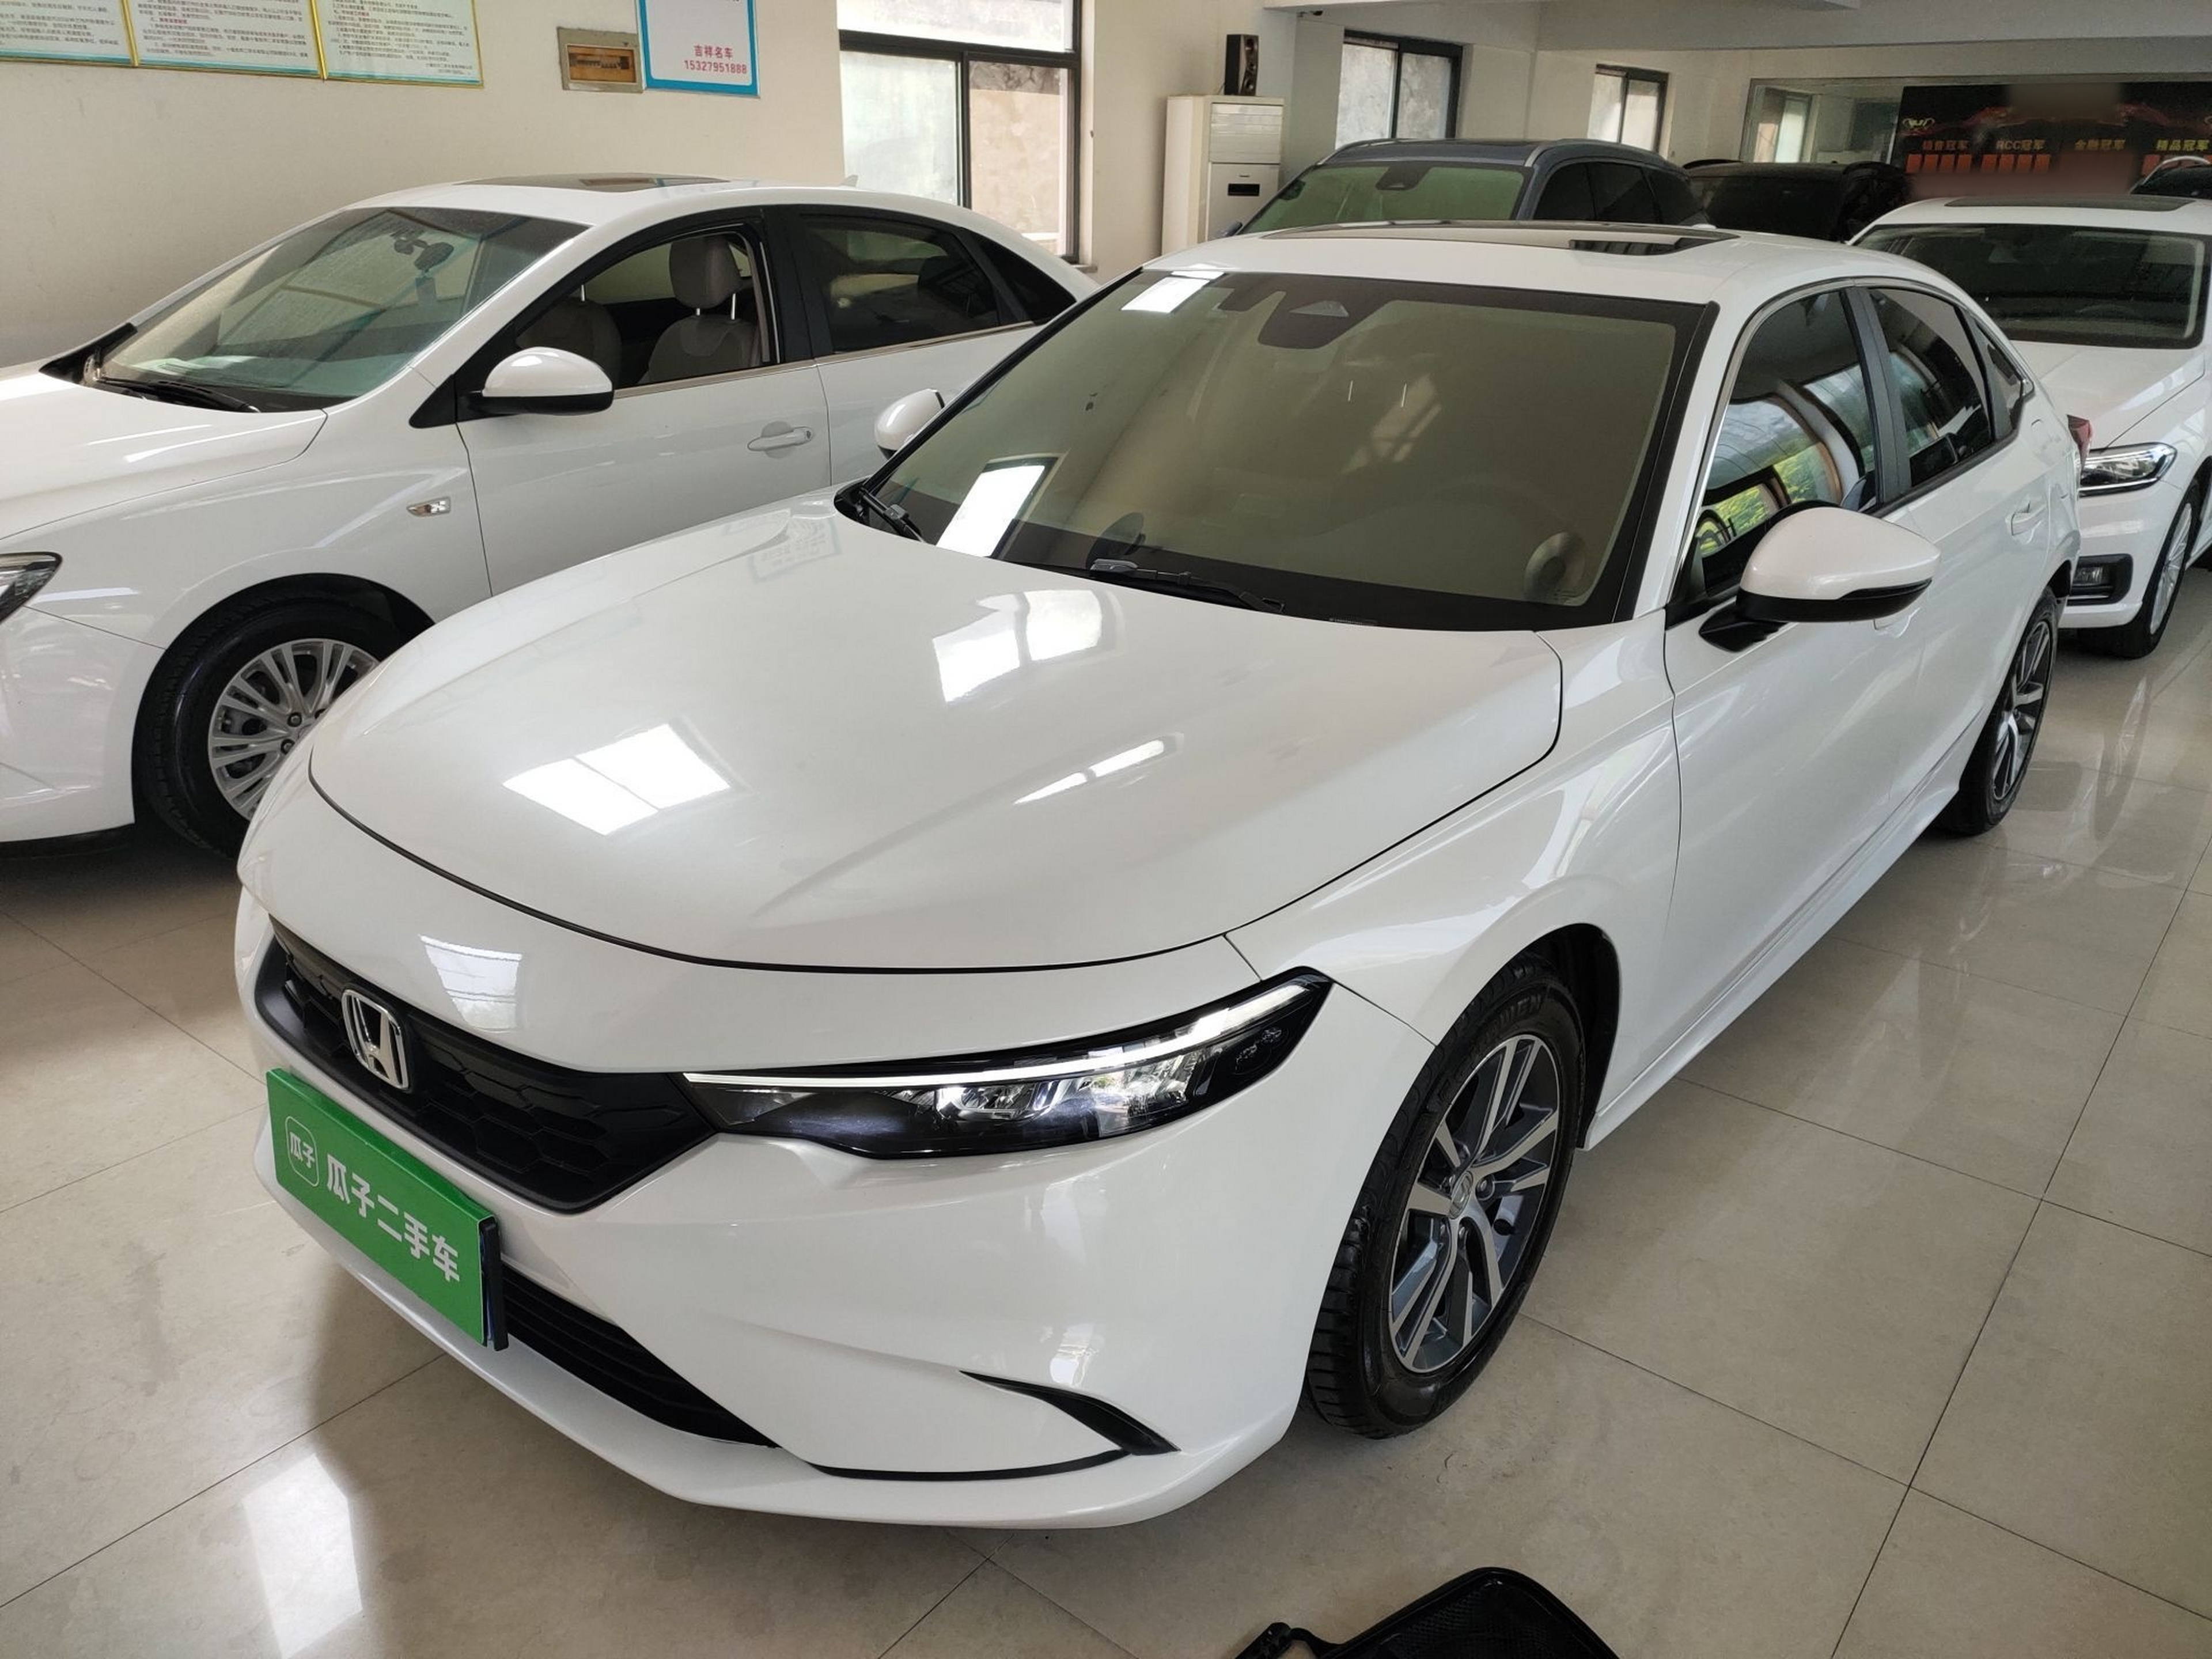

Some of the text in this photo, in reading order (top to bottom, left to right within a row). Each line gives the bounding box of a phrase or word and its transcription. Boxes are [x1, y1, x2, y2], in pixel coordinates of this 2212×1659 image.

[694, 45, 733, 60] 吉祥名车
[684, 60, 747, 74] 15327951888
[289, 1132, 315, 1168] 瓜子
[327, 1154, 460, 1282] 瓜子二手车
